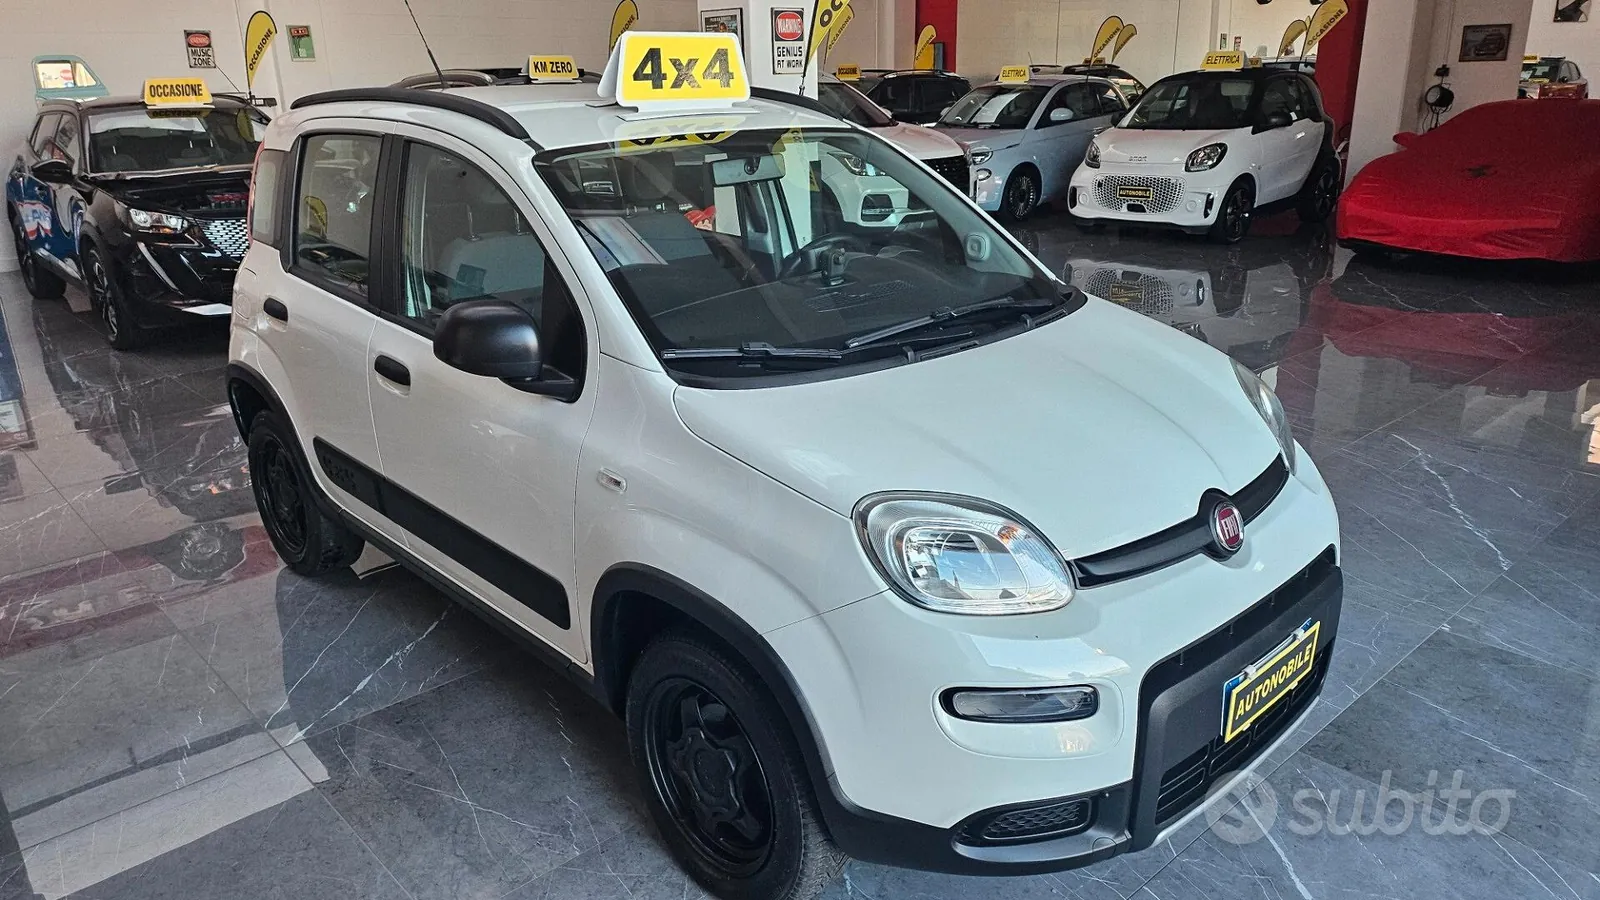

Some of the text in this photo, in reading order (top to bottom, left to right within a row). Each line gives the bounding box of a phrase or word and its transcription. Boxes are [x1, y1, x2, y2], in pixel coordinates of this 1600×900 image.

[828, 15, 852, 50] OCCASIONE
[1307, 8, 1345, 46] OCCASIONE
[1093, 27, 1120, 58] OCCASIONE
[191, 48, 211, 57] MUSIC
[249, 28, 273, 71] OCCASIONE
[776, 46, 803, 57] GENIUS
[193, 58, 211, 66] ZONE
[777, 60, 803, 68] AT WORK
[1206, 55, 1240, 64] ELETTRICA
[533, 61, 573, 73] KM ZERO
[632, 47, 735, 90] 4x4
[1002, 69, 1026, 78] ELETTRICA
[149, 84, 203, 97] OCCASIONE
[1221, 514, 1239, 540] FIAT
[1235, 643, 1313, 721] AUTONOBILE
